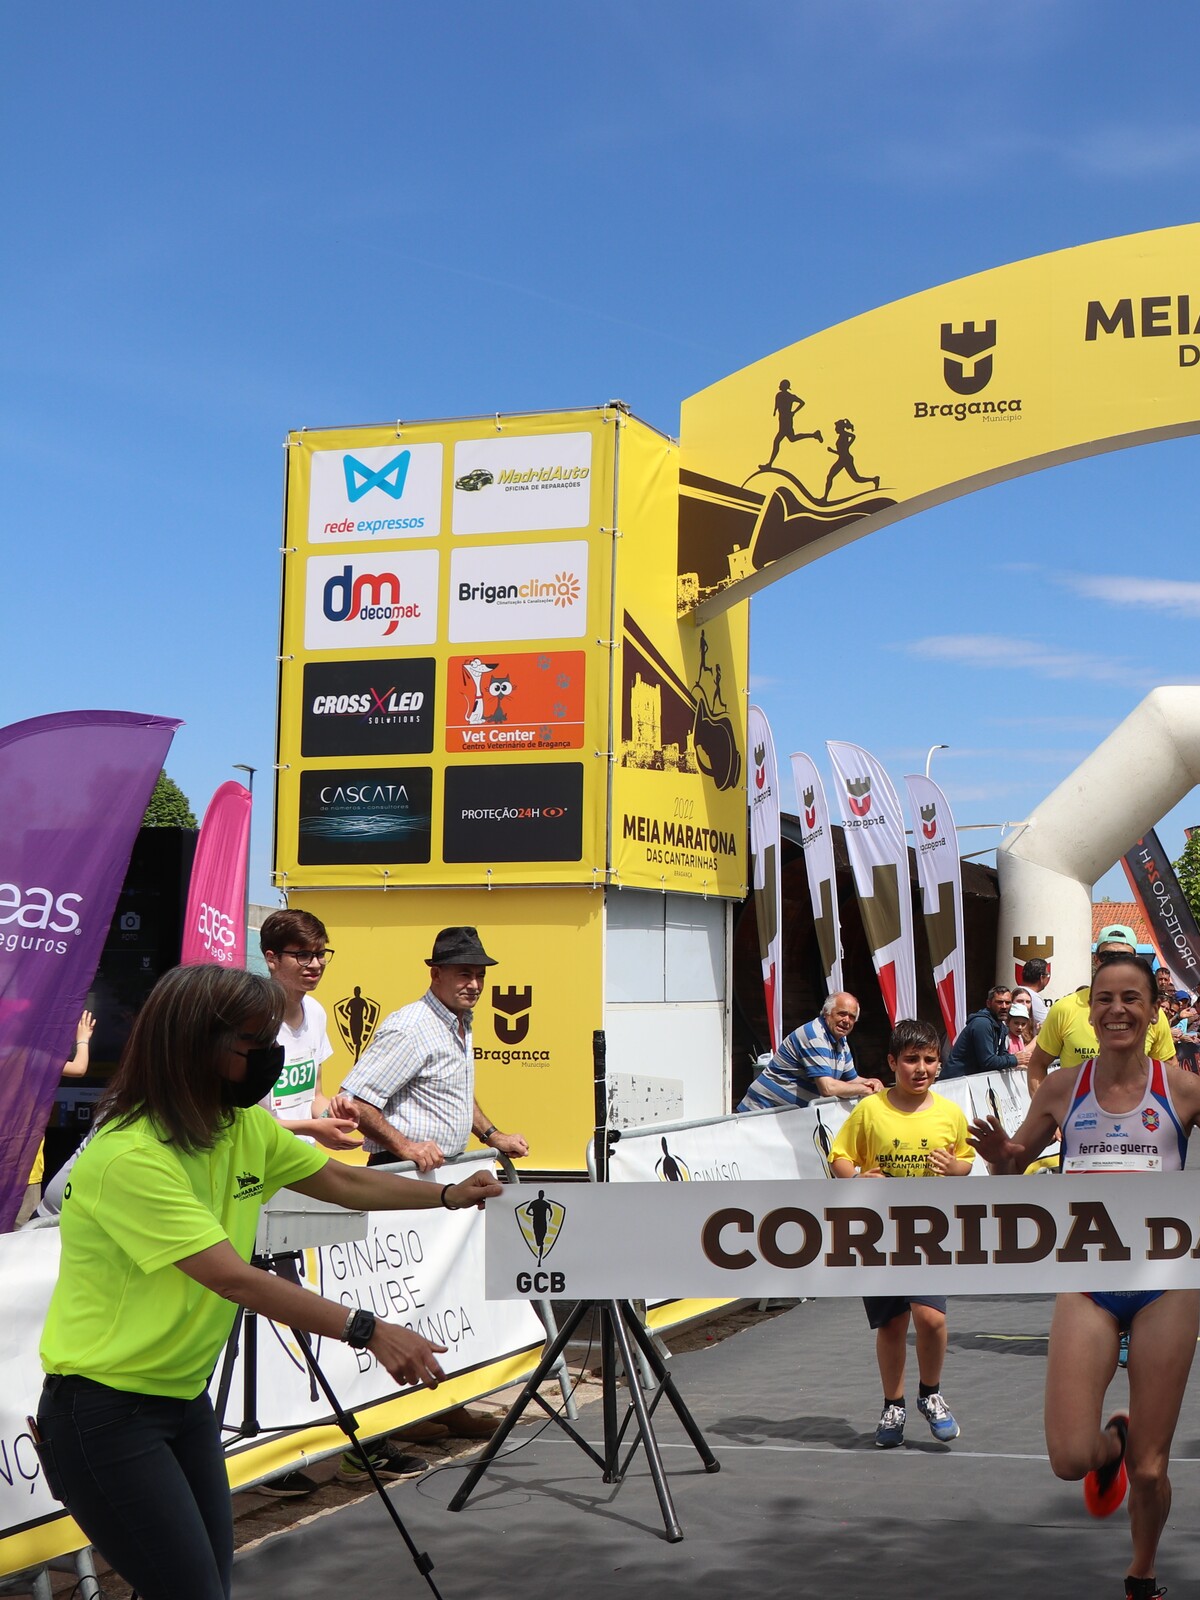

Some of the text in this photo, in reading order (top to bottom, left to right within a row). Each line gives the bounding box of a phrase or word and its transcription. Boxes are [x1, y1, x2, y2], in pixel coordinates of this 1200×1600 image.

[914, 400, 1022, 421] Bragança
[497, 466, 589, 484] MadridAuto
[541, 481, 581, 490] REPARAÇÕES
[324, 517, 425, 535] rede expressos
[458, 579, 570, 604] Briganclima
[360, 603, 421, 621] decomat
[462, 729, 536, 742] Vet Center
[487, 741, 526, 749] Veterinário
[538, 741, 571, 749] Bragança
[320, 785, 409, 804] CASCATA
[461, 807, 540, 821] PROTEÇÃO24H
[674, 797, 694, 820] 2022
[623, 814, 737, 856] MEIA MARATONA
[646, 848, 718, 871] DAS CANTARINHAS
[473, 1047, 550, 1065] Bragança
[277, 1062, 314, 1089] 3037
[700, 1201, 1131, 1270] CORRIDA
[329, 1227, 424, 1281] GINÁSIO
[515, 1271, 567, 1294] GCB
